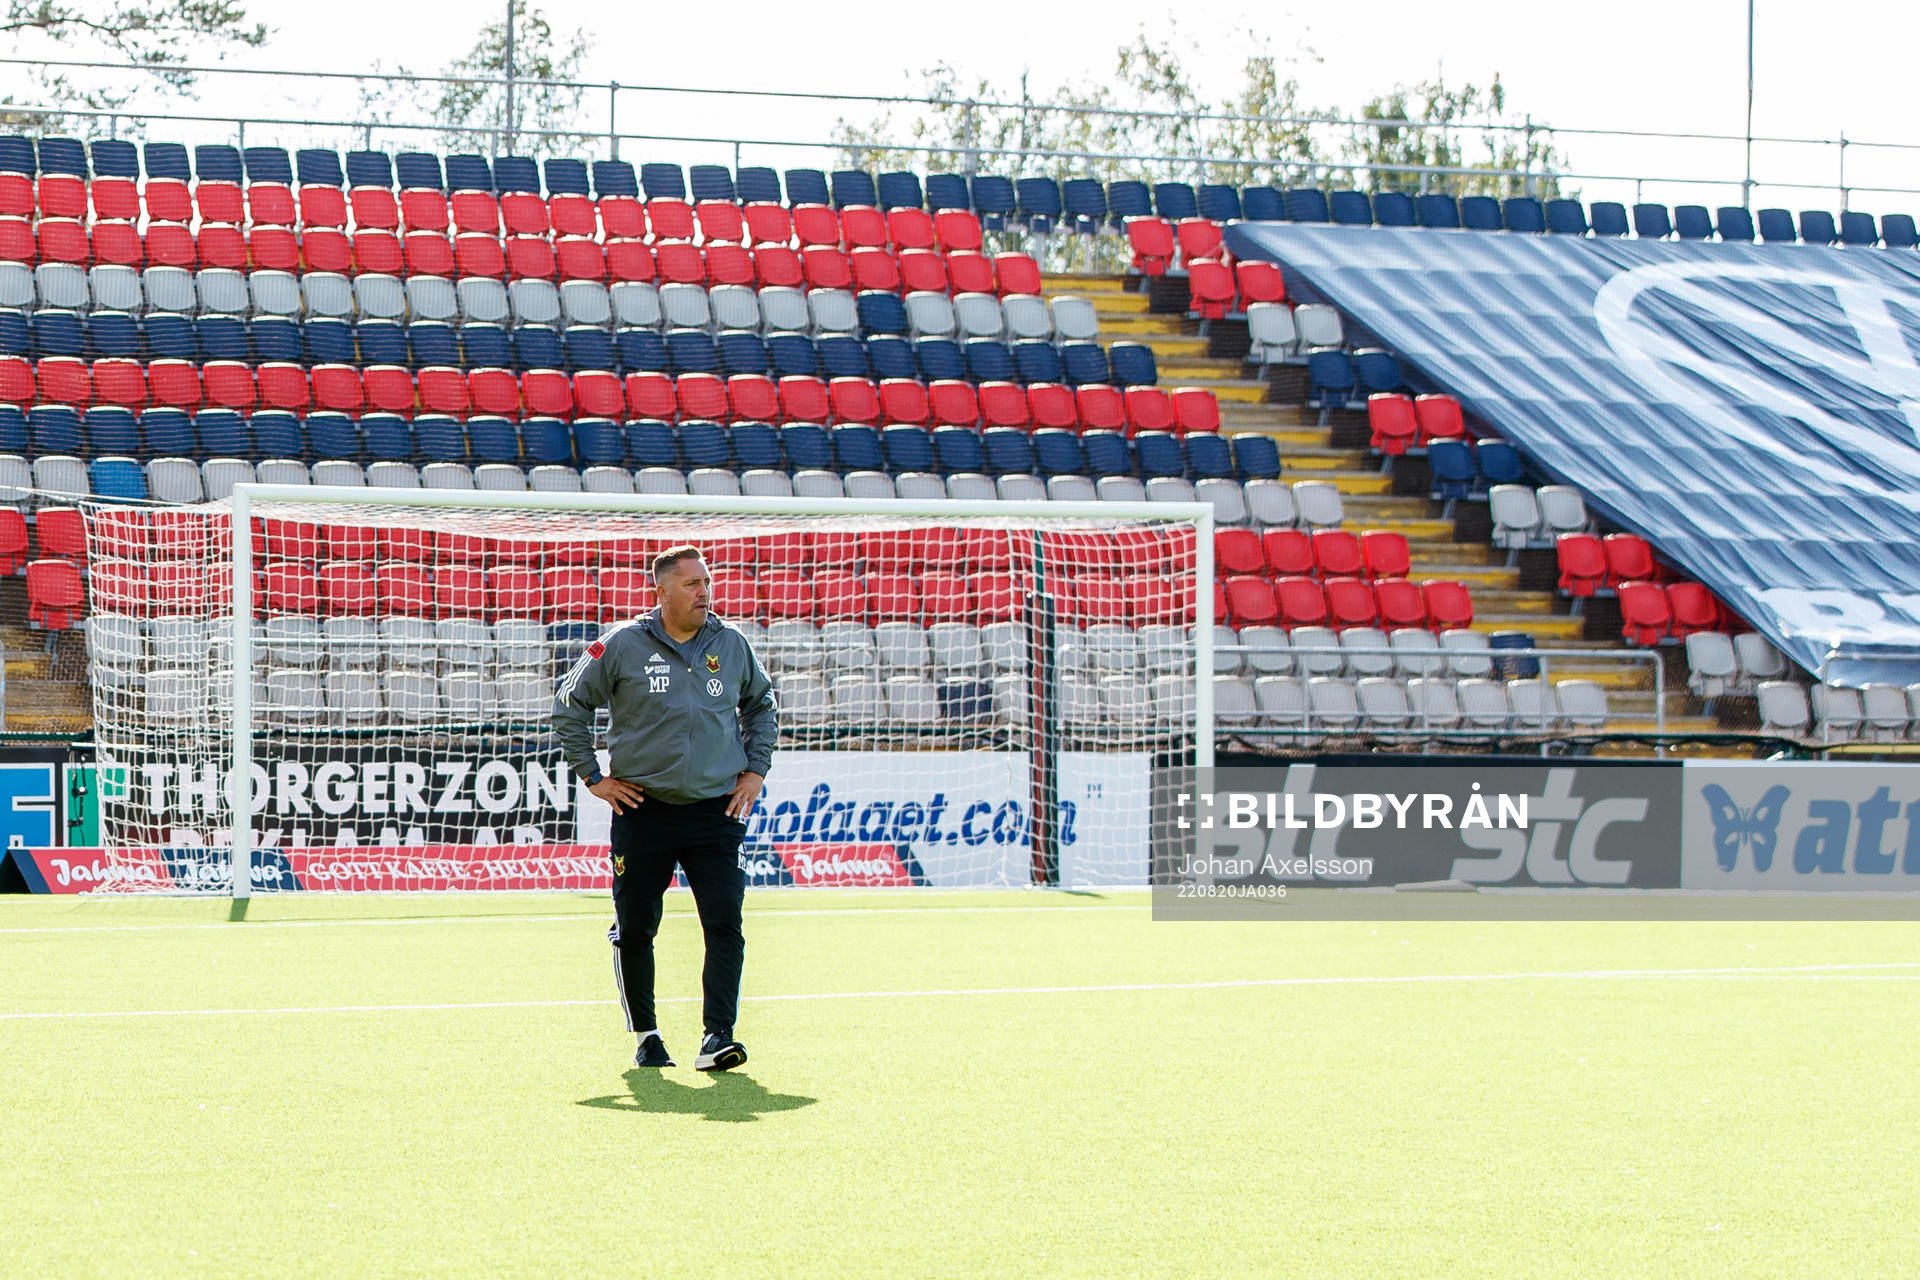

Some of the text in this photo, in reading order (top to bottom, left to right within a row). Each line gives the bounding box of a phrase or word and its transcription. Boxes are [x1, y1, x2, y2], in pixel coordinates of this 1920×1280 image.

[649, 676, 670, 693] MP
[142, 760, 571, 815] THORGERZON
[309, 861, 381, 881] GOTT
[553, 857, 613, 876] ENK
